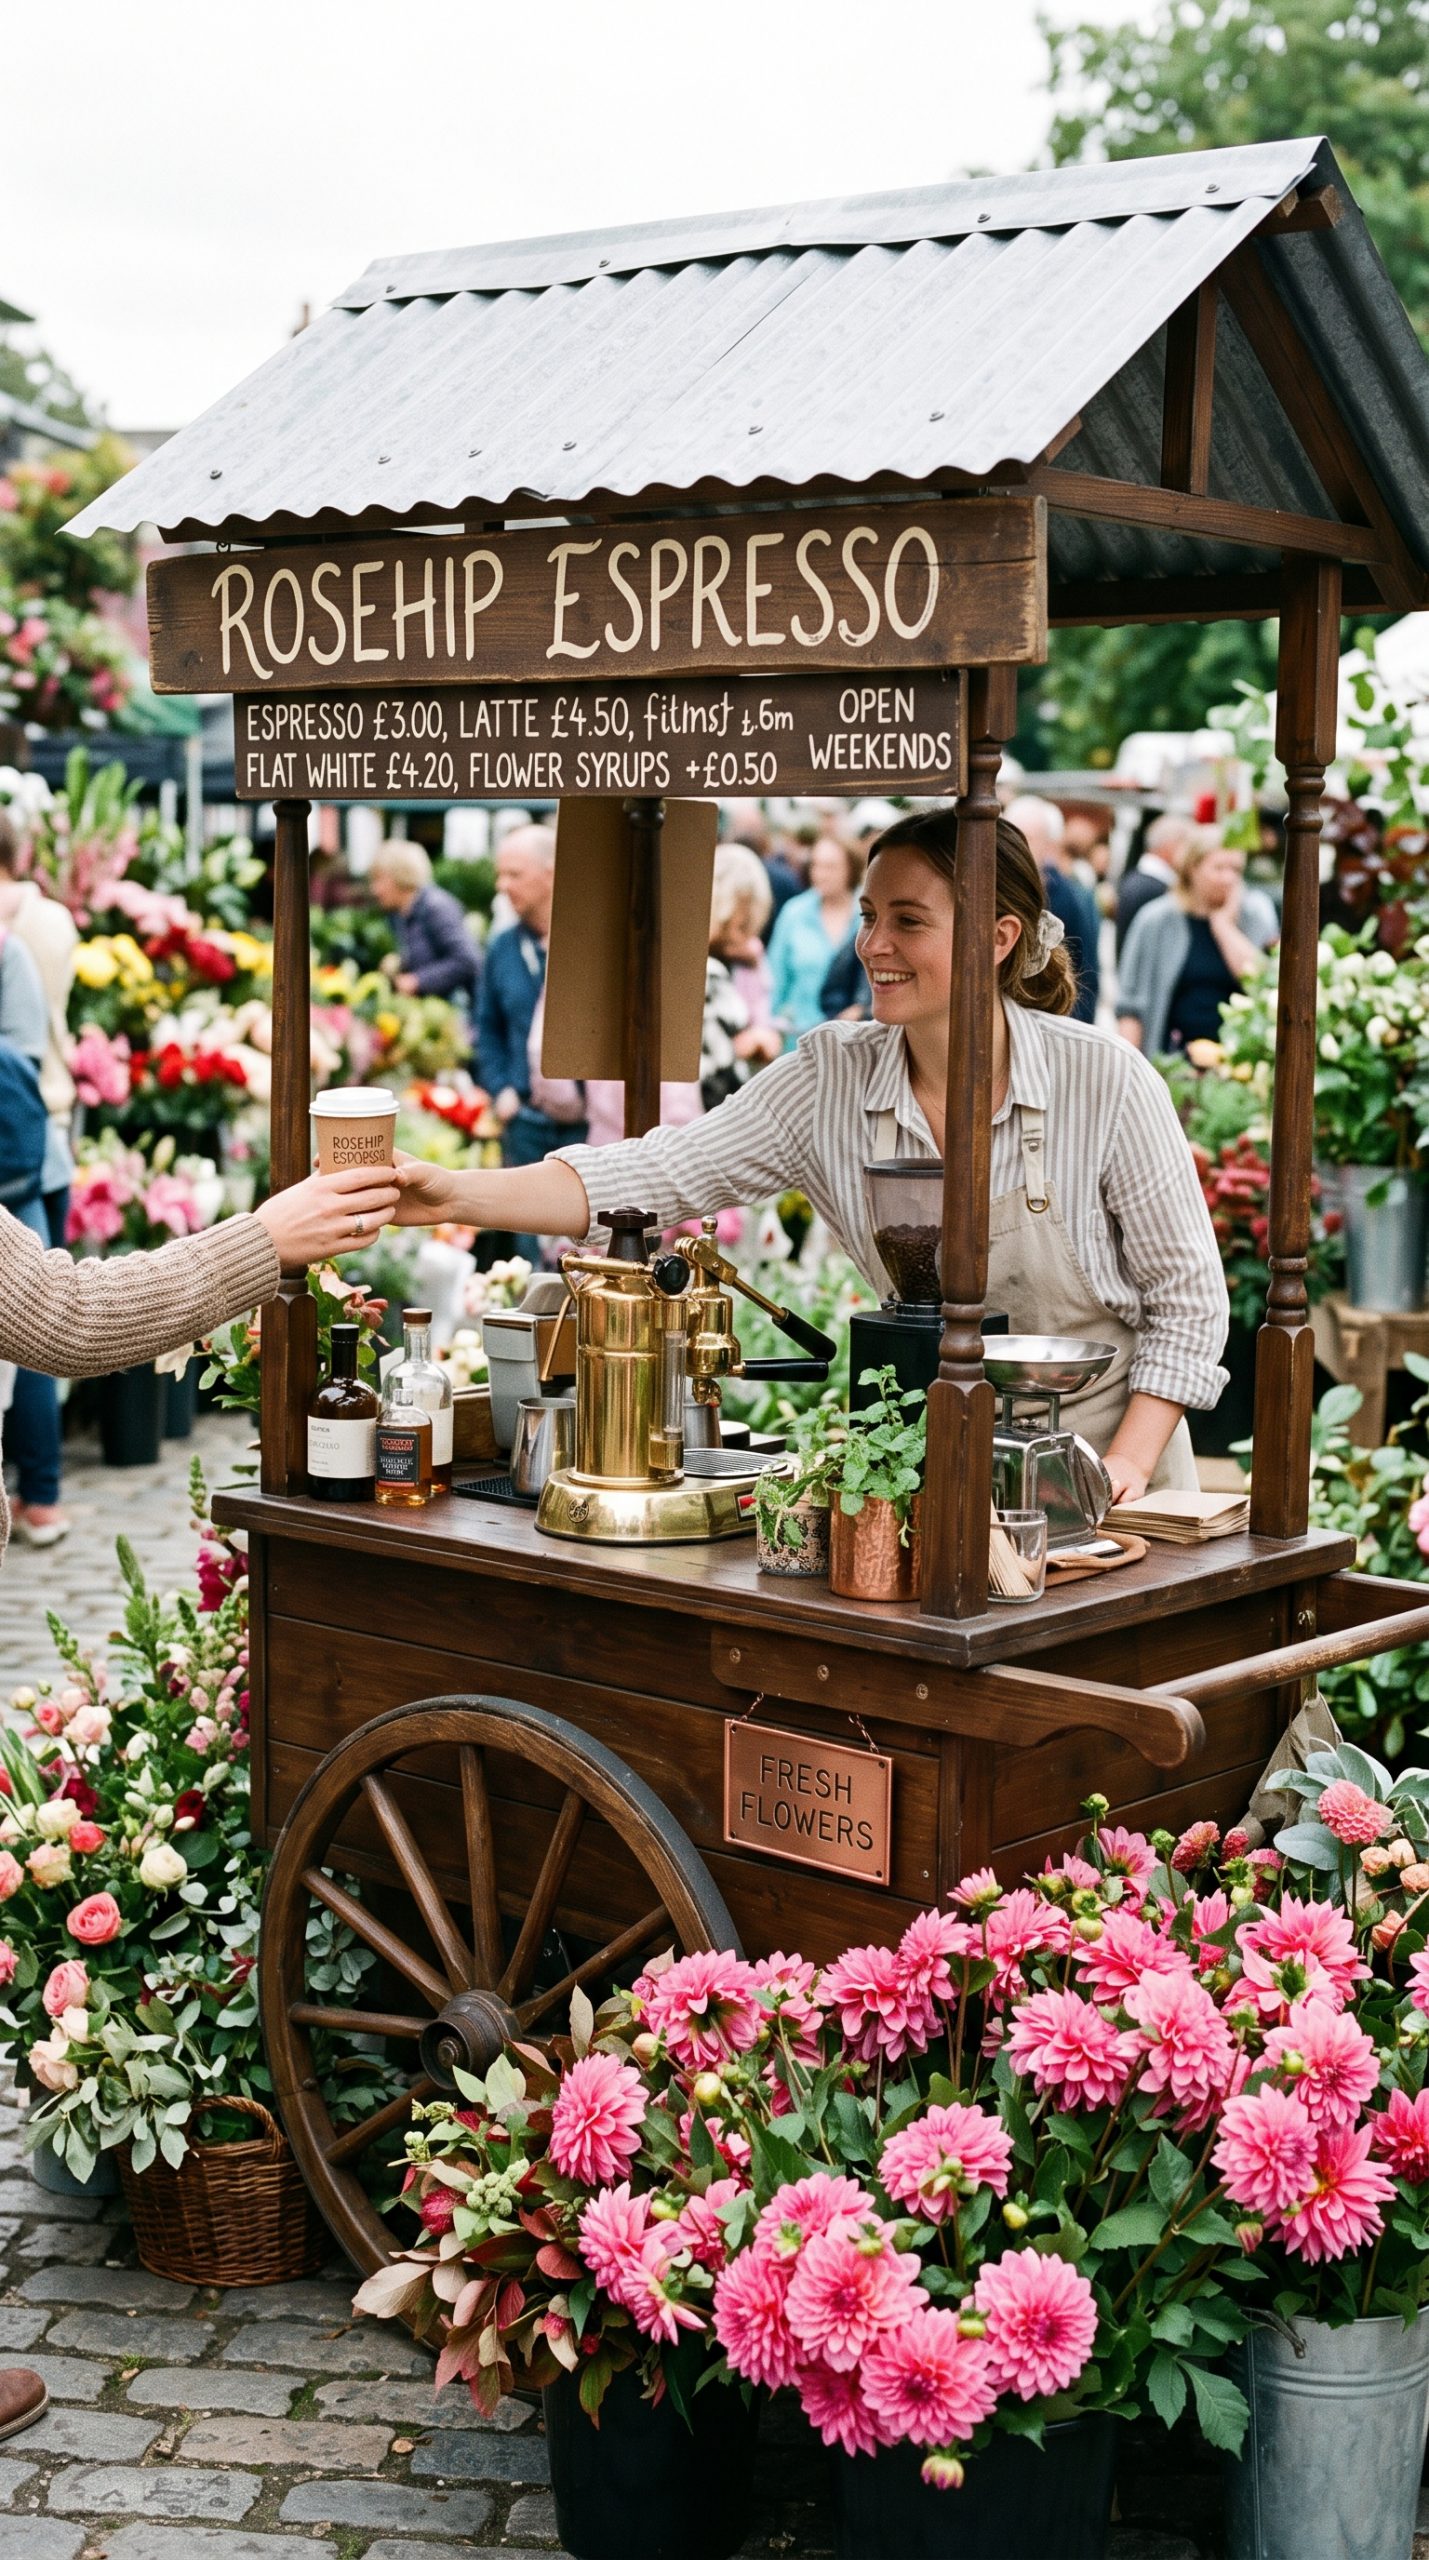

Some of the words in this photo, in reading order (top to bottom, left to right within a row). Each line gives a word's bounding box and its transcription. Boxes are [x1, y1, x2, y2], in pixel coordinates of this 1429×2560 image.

[211, 549, 504, 680] ROSEHIP
[545, 525, 940, 660] ESPRESSO
[247, 702, 364, 741] ESPRESSO
[373, 701, 448, 744] £3.00,
[460, 699, 540, 738] LATTE
[550, 697, 634, 743] £4.50,
[839, 687, 914, 724] OPEN
[247, 752, 298, 788] FLAT
[305, 752, 377, 788] WHITE
[385, 751, 459, 794] £4.20,
[470, 752, 565, 788] FLOWER
[575, 751, 670, 788] SYRUPS
[685, 751, 778, 789] +£0.50
[808, 731, 952, 771] WEEKENDS
[333, 1135, 384, 1150] ROSEHIP
[760, 1754, 852, 1805] FRESH
[741, 1791, 874, 1851] FLOWERS
